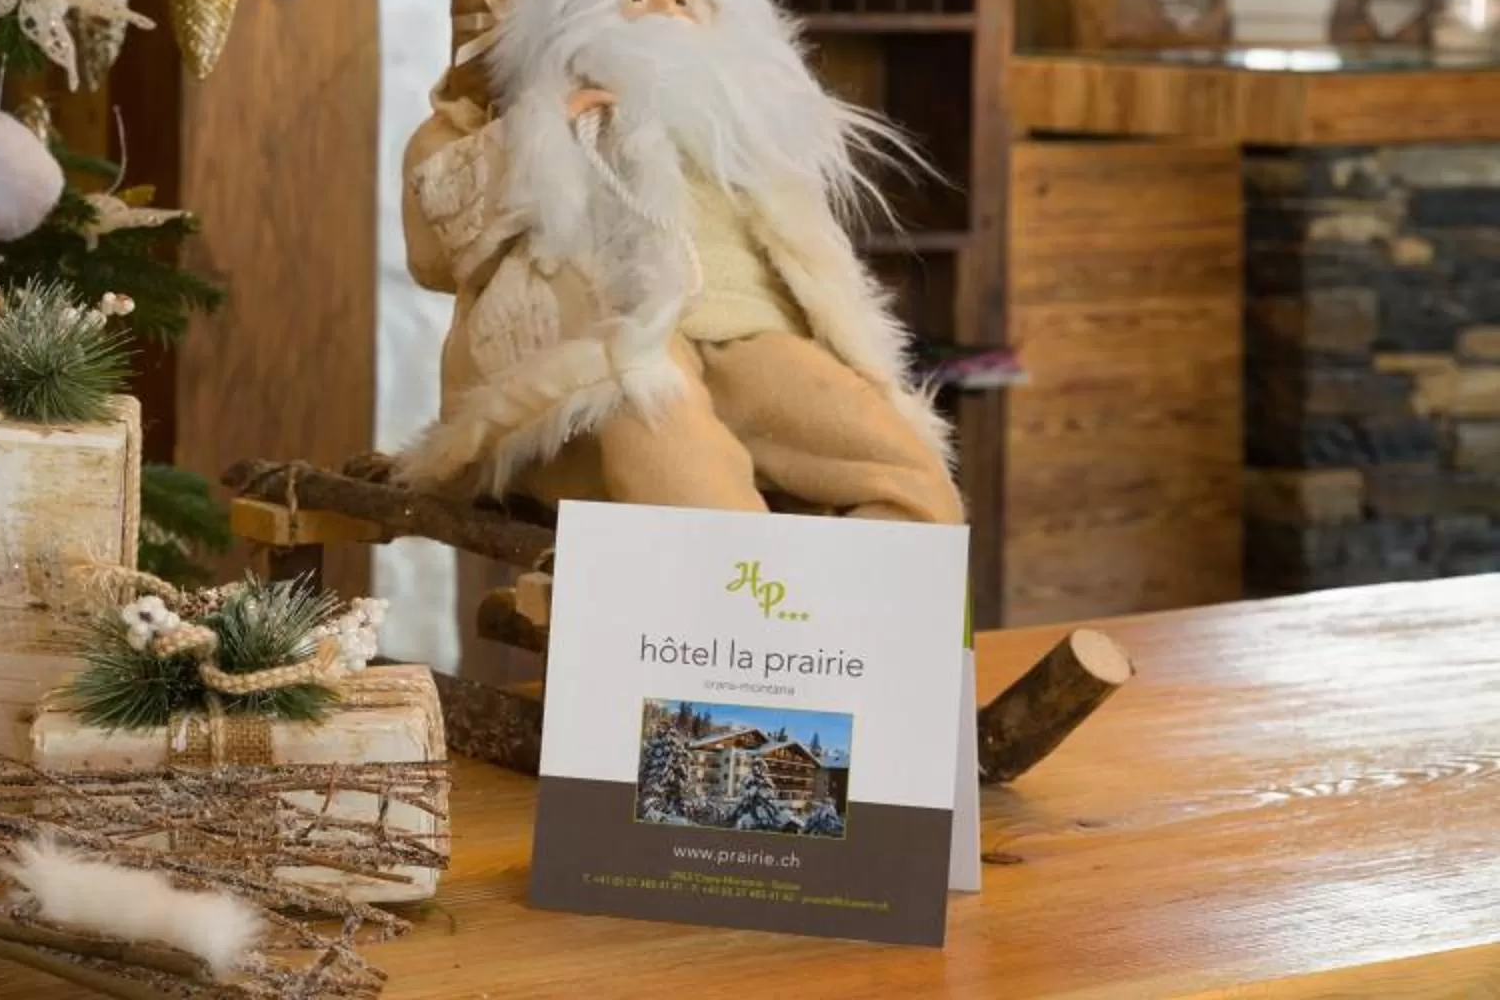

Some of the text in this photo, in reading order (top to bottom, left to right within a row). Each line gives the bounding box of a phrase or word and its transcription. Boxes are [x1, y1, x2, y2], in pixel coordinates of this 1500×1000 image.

[640, 633, 865, 679] hôtel la prairie
[673, 845, 801, 869] www.prairie.ch
